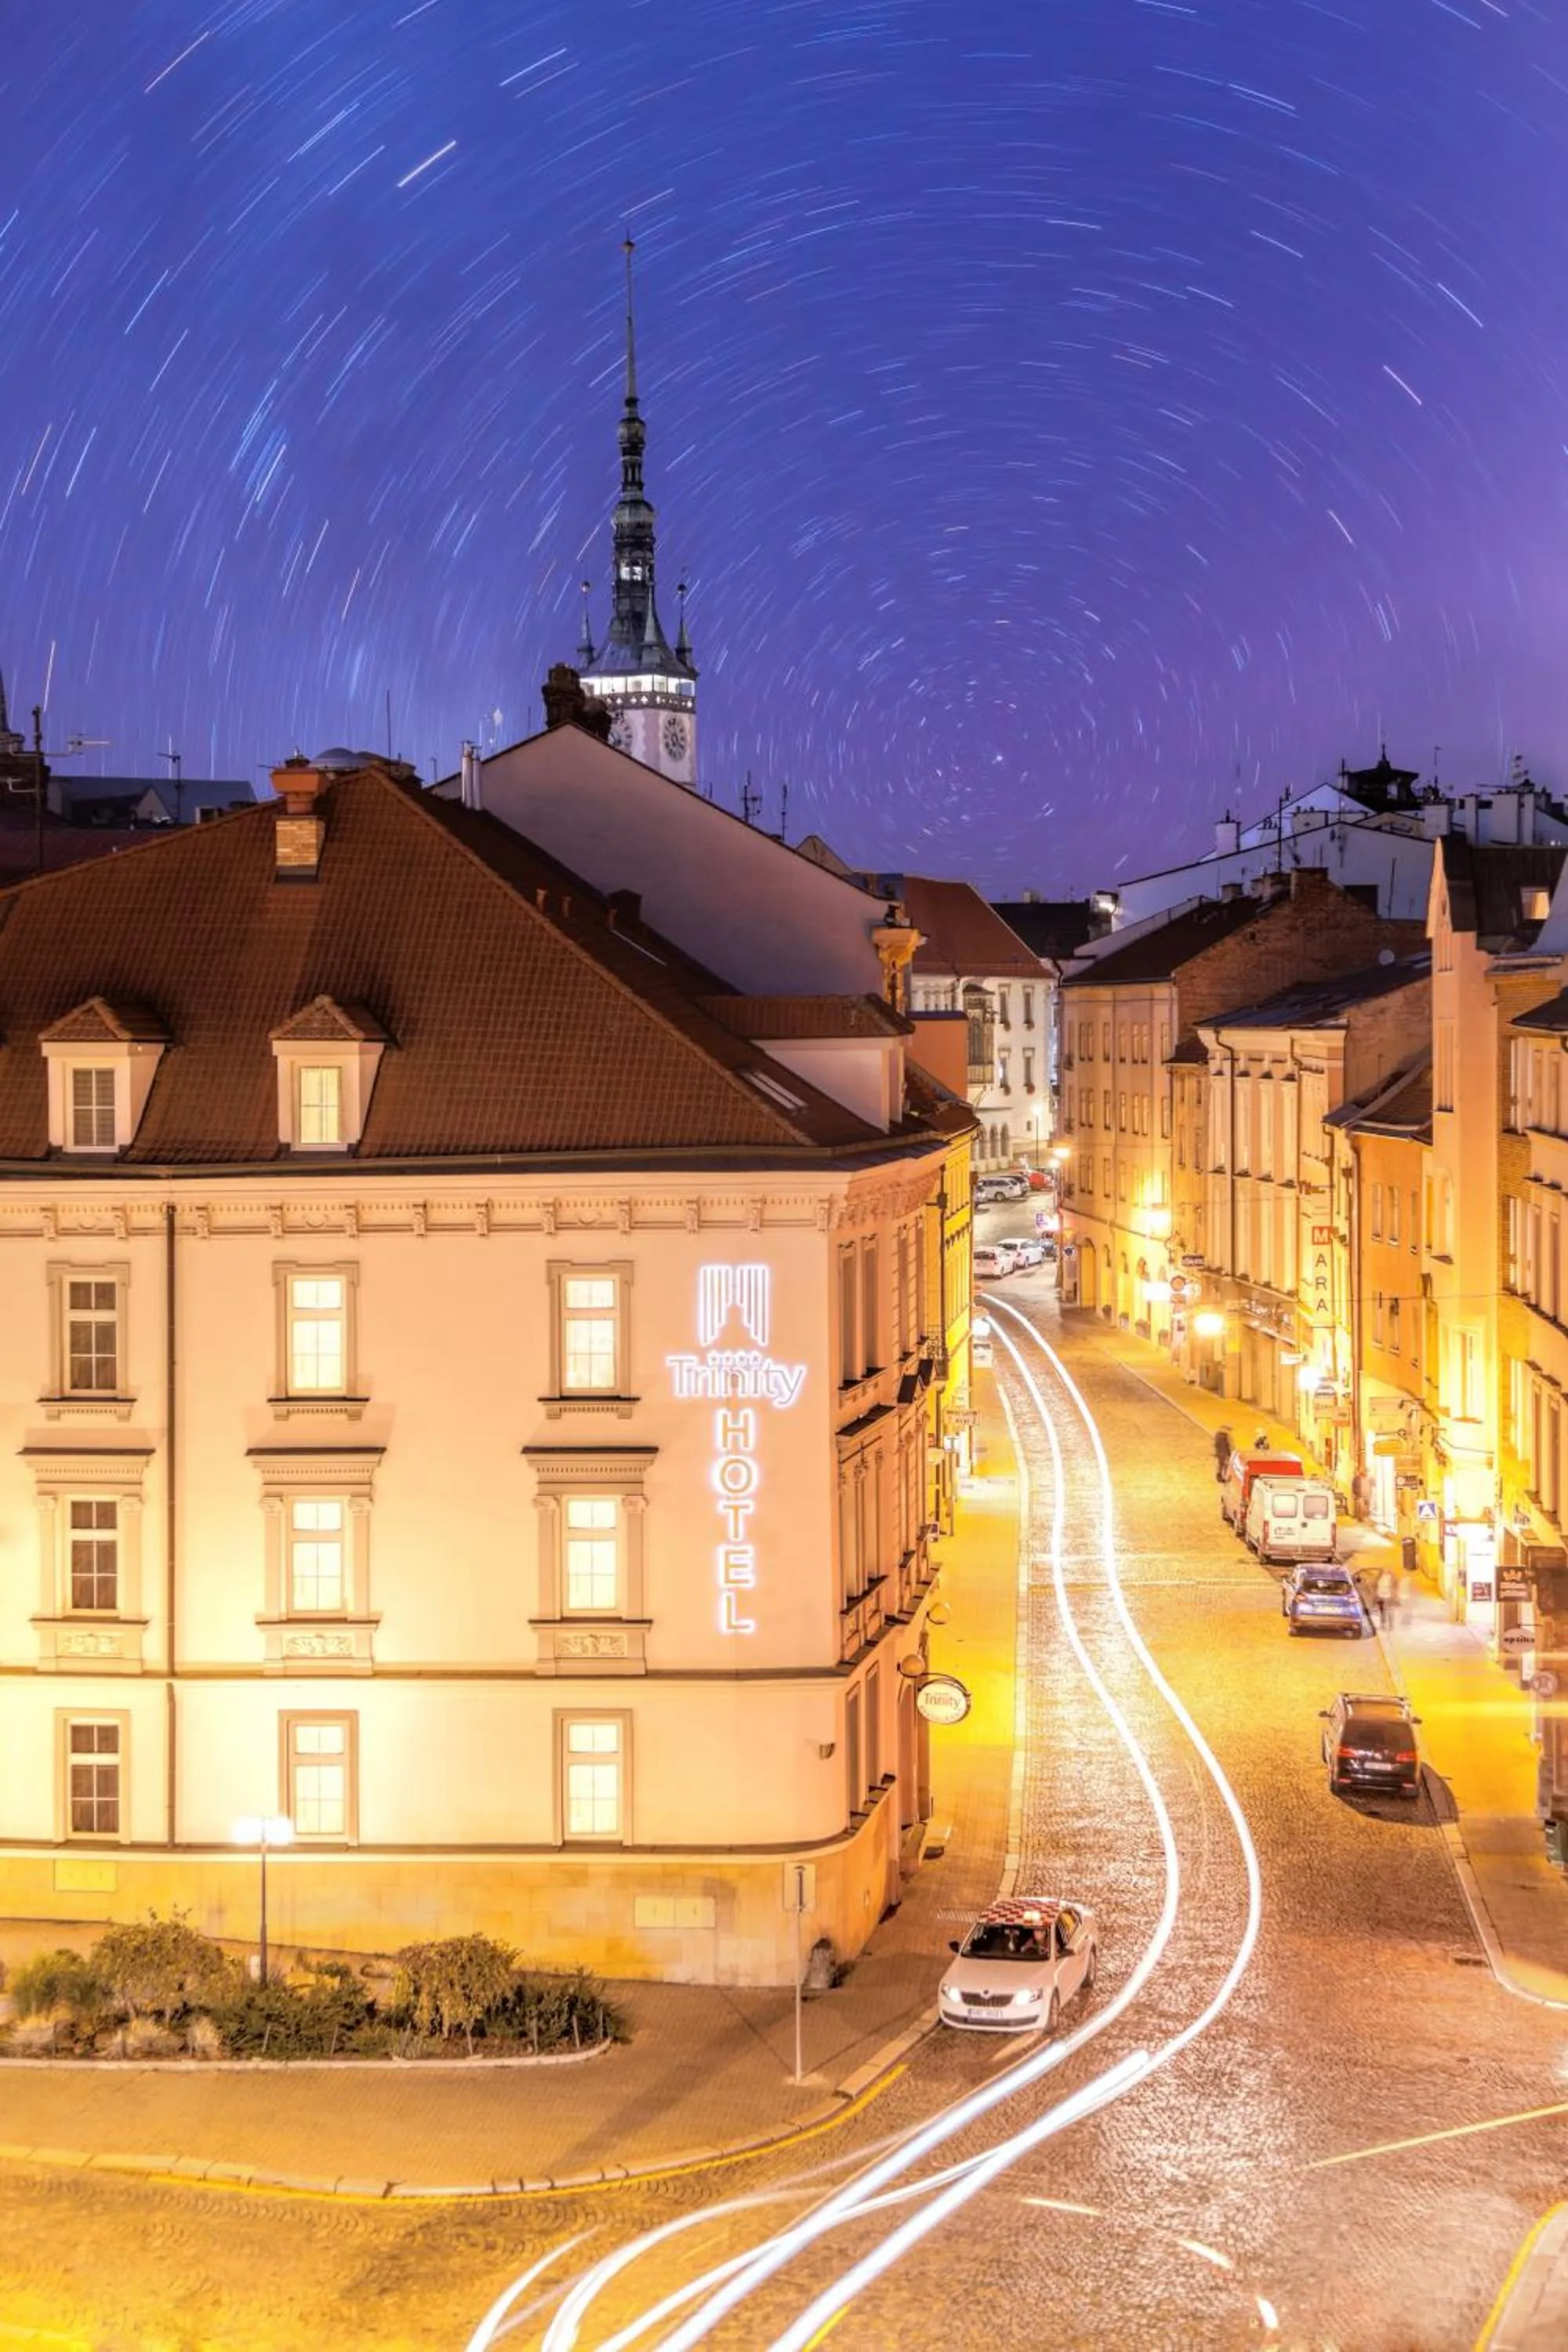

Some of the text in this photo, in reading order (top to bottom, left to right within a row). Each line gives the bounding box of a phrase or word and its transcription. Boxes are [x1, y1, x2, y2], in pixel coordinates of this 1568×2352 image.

[1312, 1226, 1330, 1312] MARA
[666, 1356, 806, 1407] Trinity
[717, 1410, 754, 1634] HOTEL
